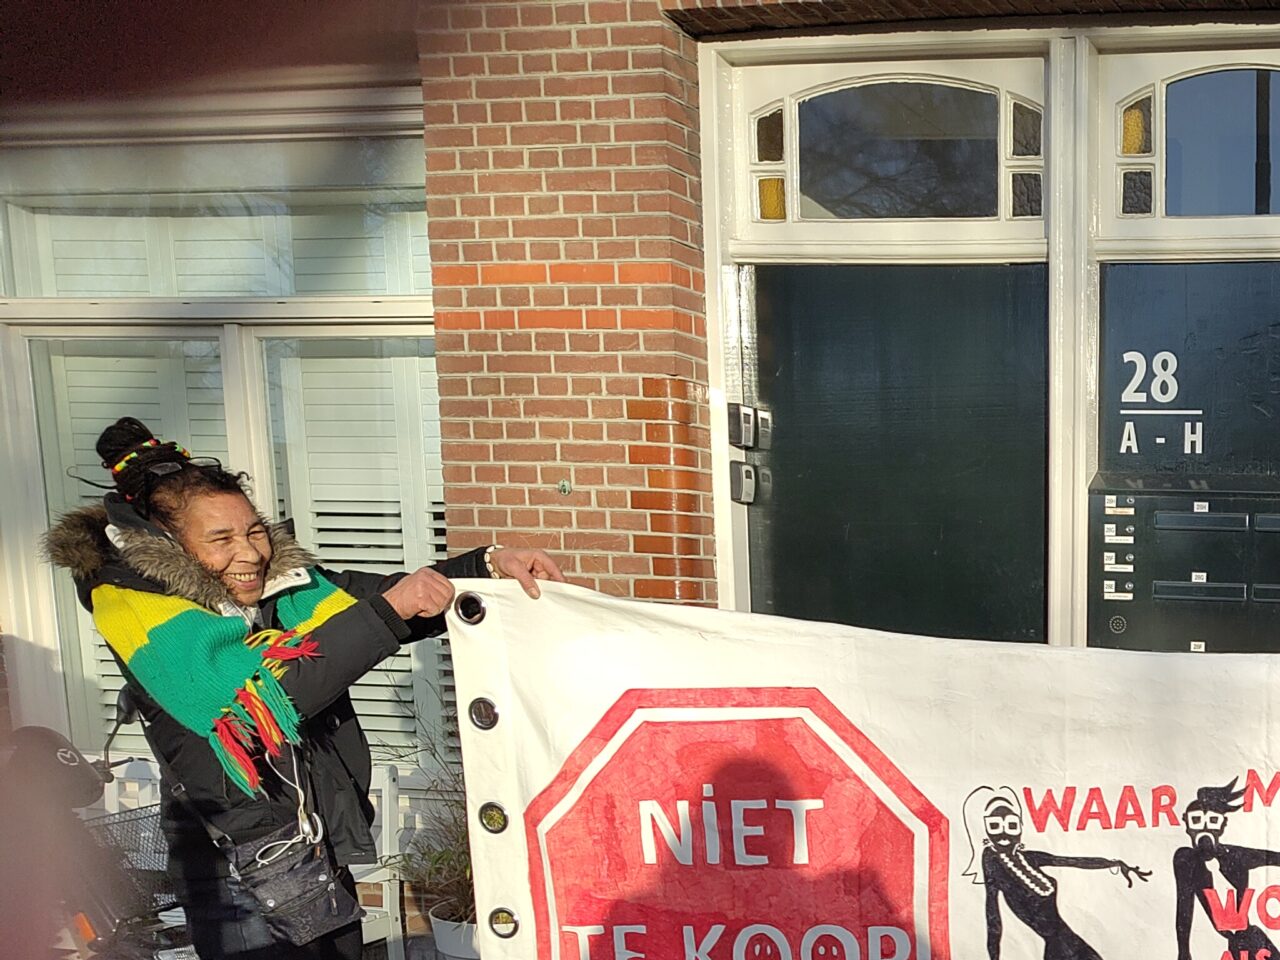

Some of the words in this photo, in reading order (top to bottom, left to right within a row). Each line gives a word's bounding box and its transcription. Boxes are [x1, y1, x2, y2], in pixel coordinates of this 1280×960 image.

[1121, 350, 1179, 403] 28
[1120, 422, 1139, 454] A
[1184, 422, 1203, 454] H
[1023, 786, 1180, 832] WAAR
